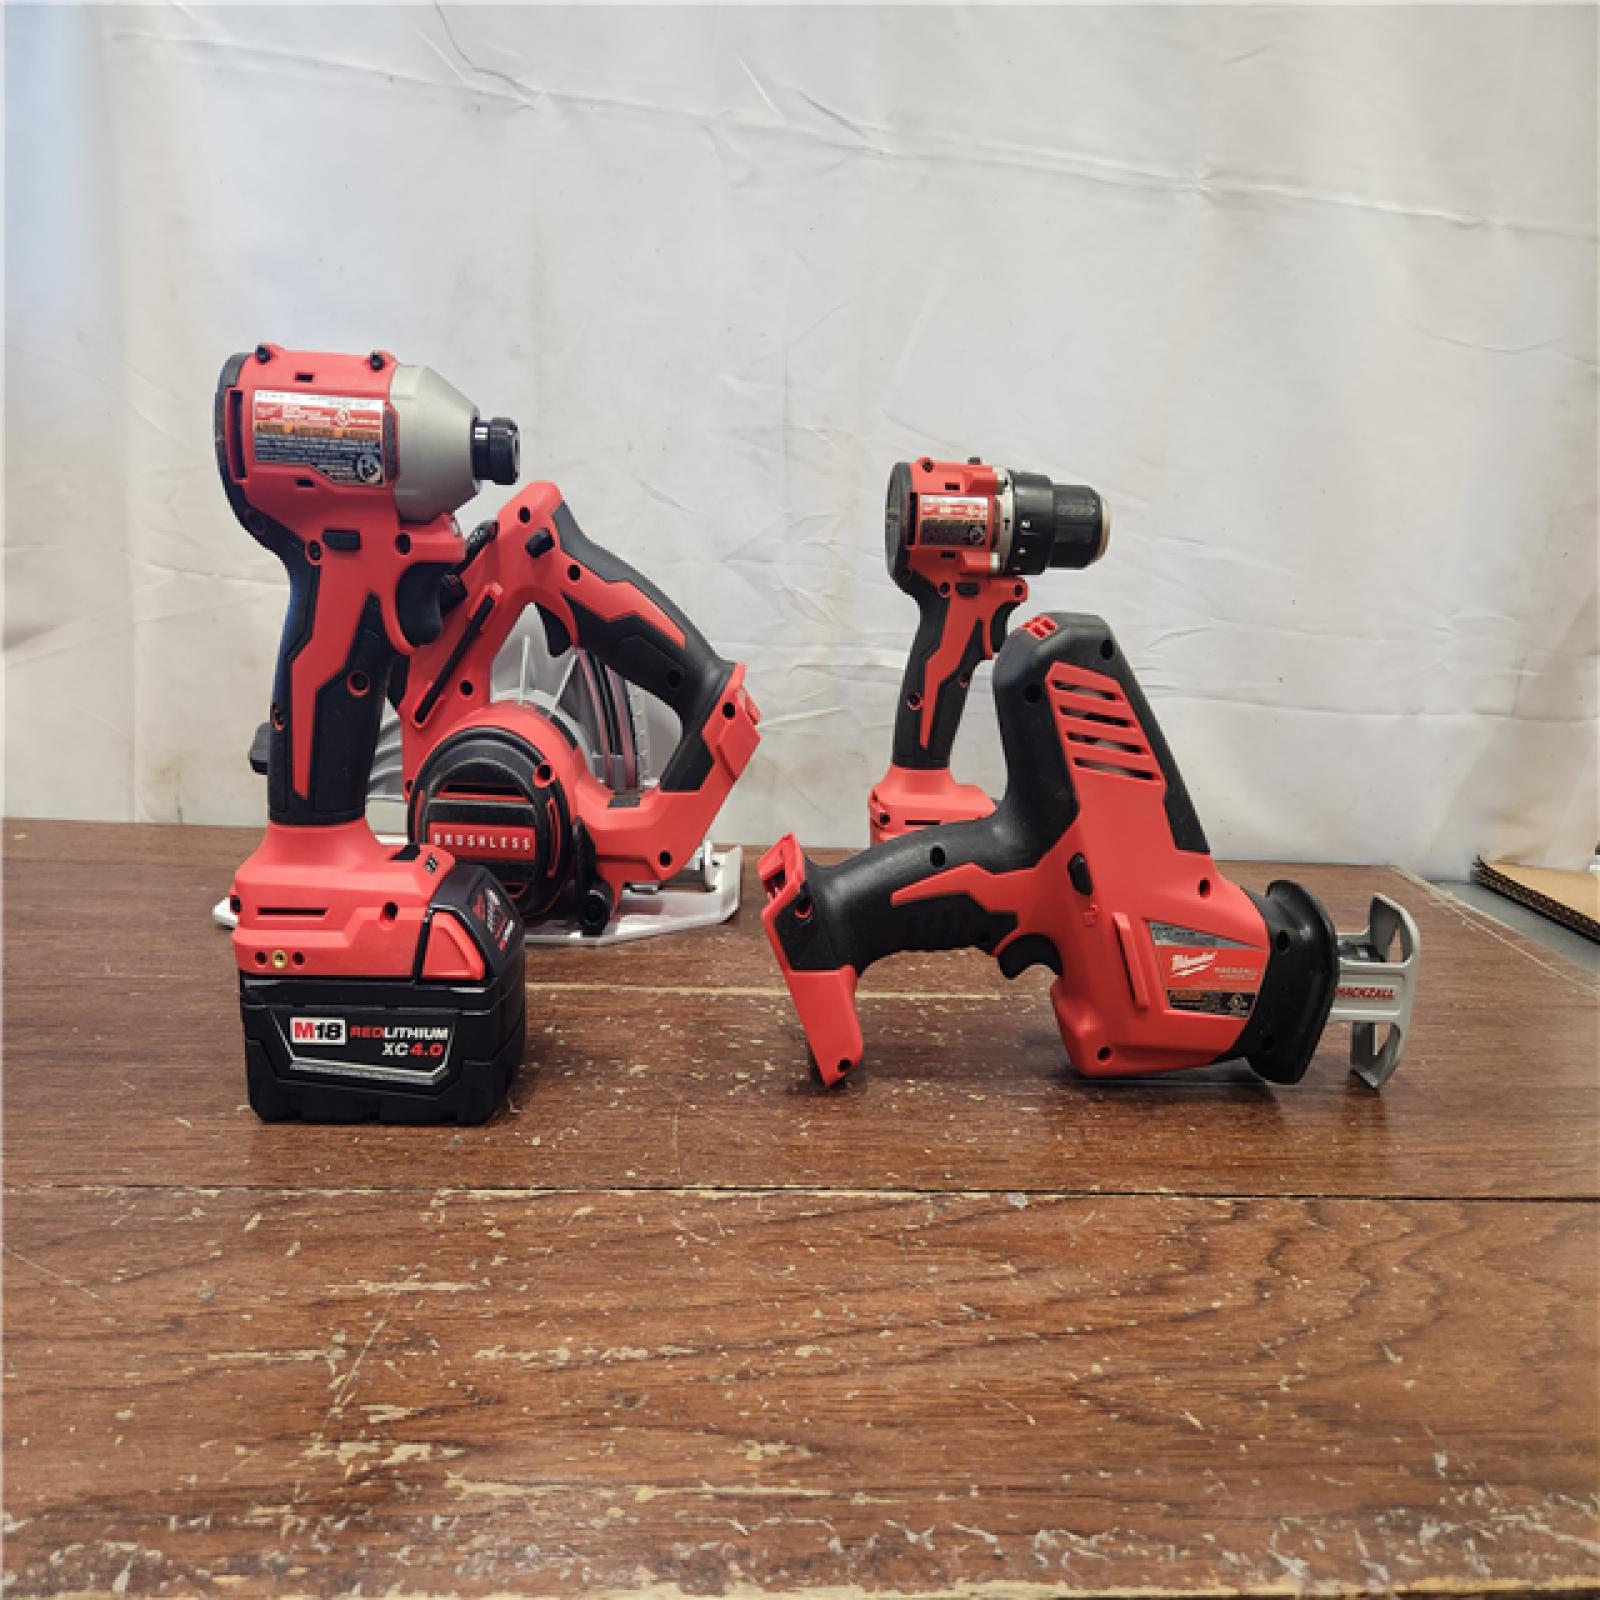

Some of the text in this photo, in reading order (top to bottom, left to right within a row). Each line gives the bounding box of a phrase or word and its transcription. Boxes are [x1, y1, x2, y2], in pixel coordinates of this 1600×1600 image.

[434, 832, 530, 851] BRUSHLESS
[294, 1021, 448, 1040] M18 REDLITHIUM
